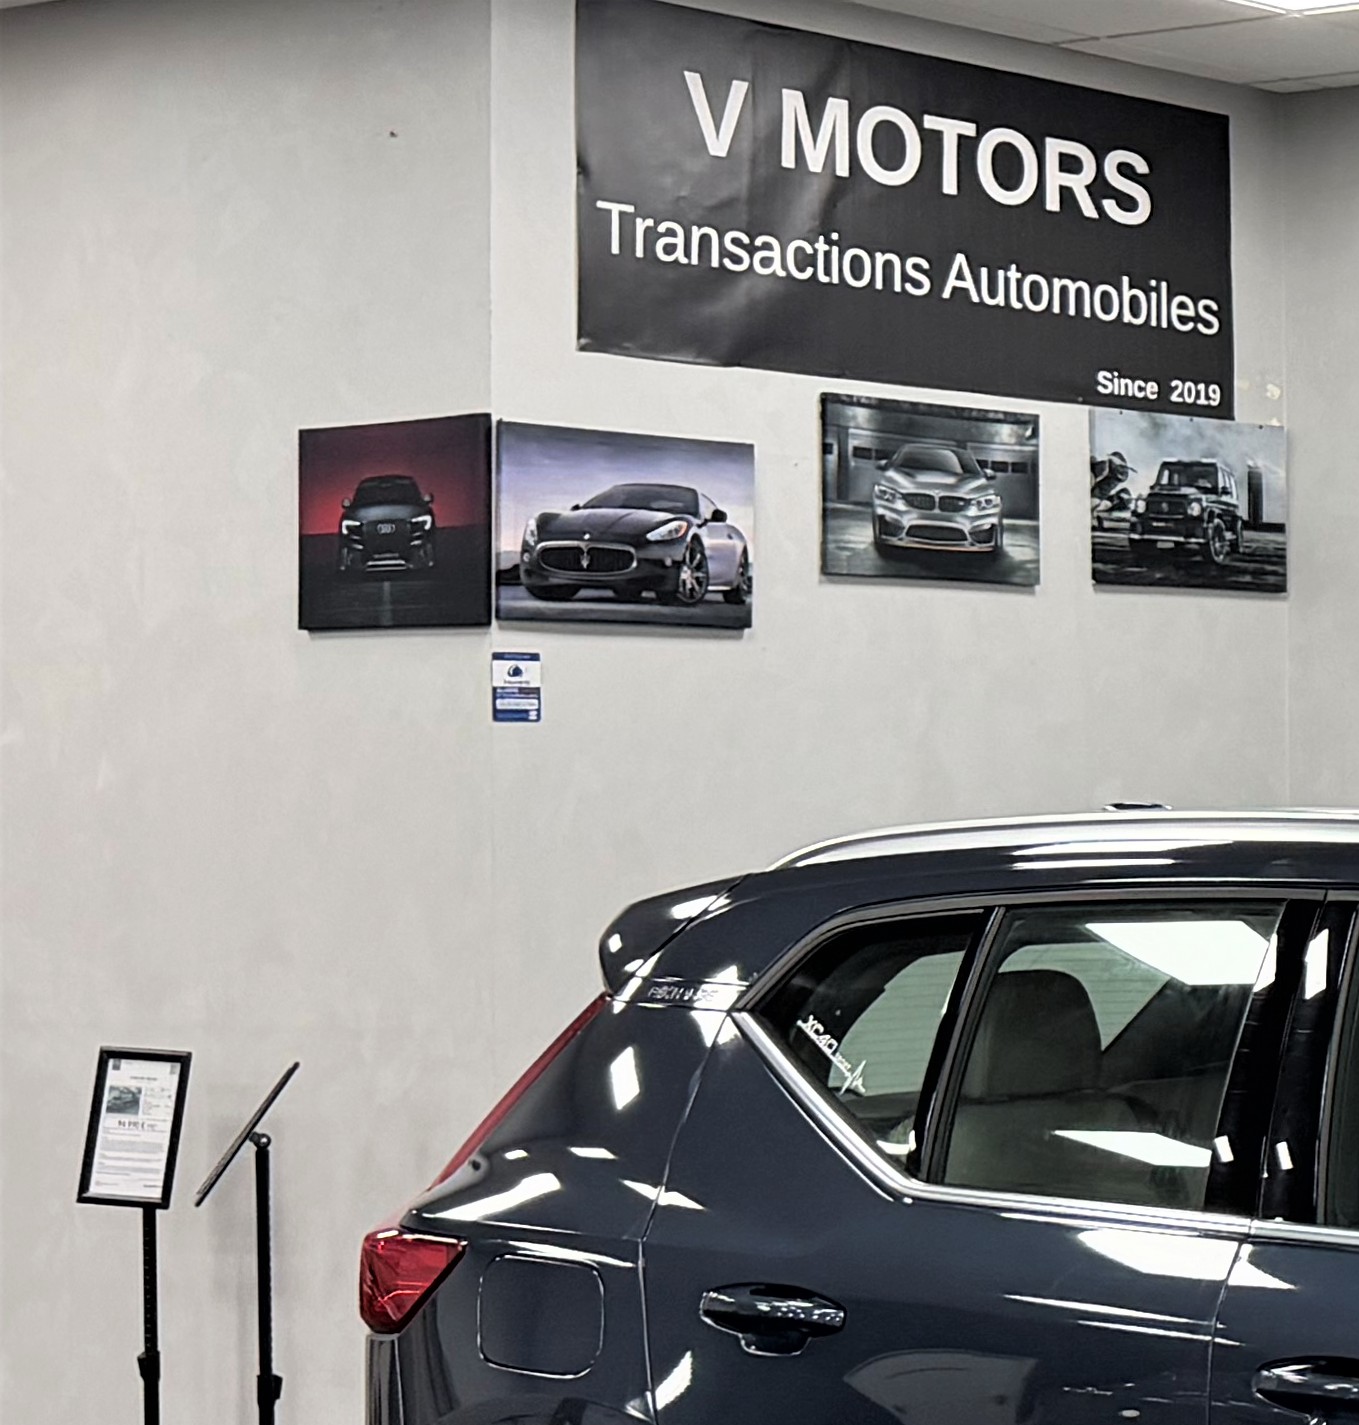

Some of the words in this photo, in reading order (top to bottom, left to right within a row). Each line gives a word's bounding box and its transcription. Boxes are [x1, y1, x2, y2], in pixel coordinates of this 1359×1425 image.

[683, 70, 750, 158] V
[780, 88, 1151, 225] MOTORS
[595, 199, 931, 296] Transactions
[941, 252, 1220, 335] Automobiles
[1096, 370, 1159, 400] Since
[1170, 380, 1221, 406] 2019
